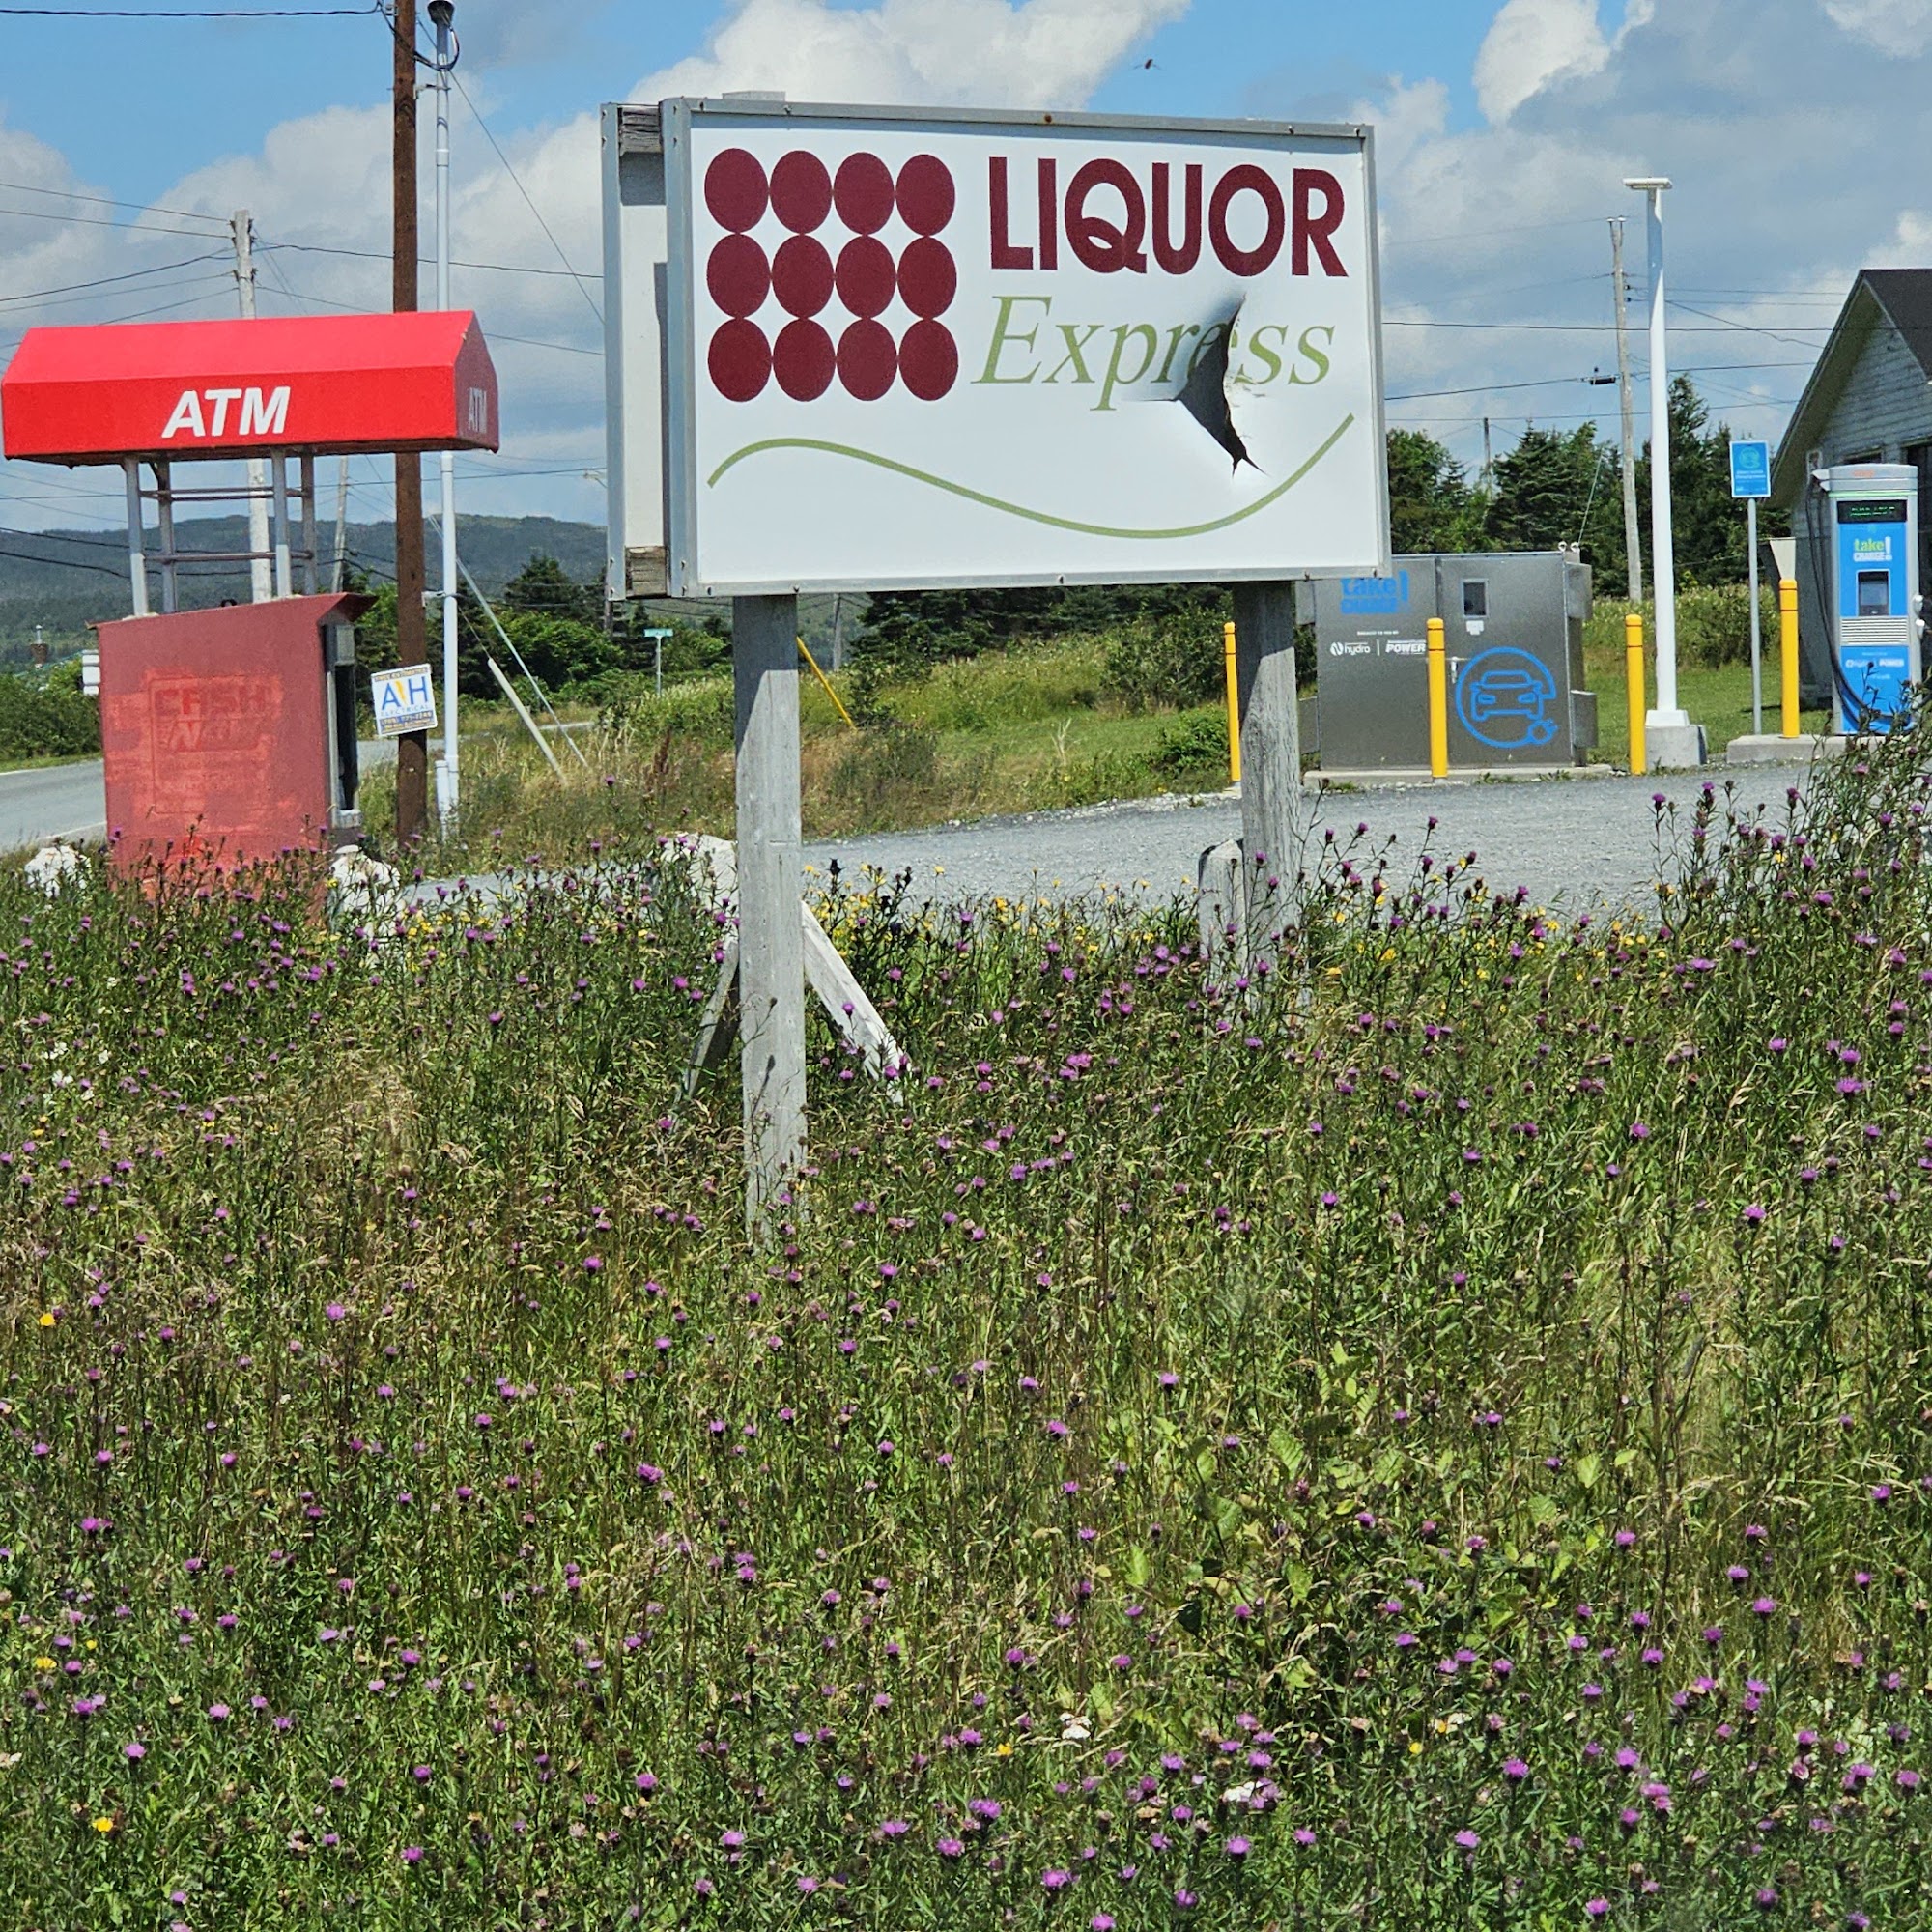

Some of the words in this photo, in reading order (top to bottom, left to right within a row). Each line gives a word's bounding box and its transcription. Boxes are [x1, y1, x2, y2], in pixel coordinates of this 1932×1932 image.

[989, 156, 1348, 277] LIQUOR
[161, 385, 291, 438] ATM
[468, 387, 487, 434] ATM
[1344, 642, 1371, 655] hydro
[1385, 643, 1426, 653] POWER
